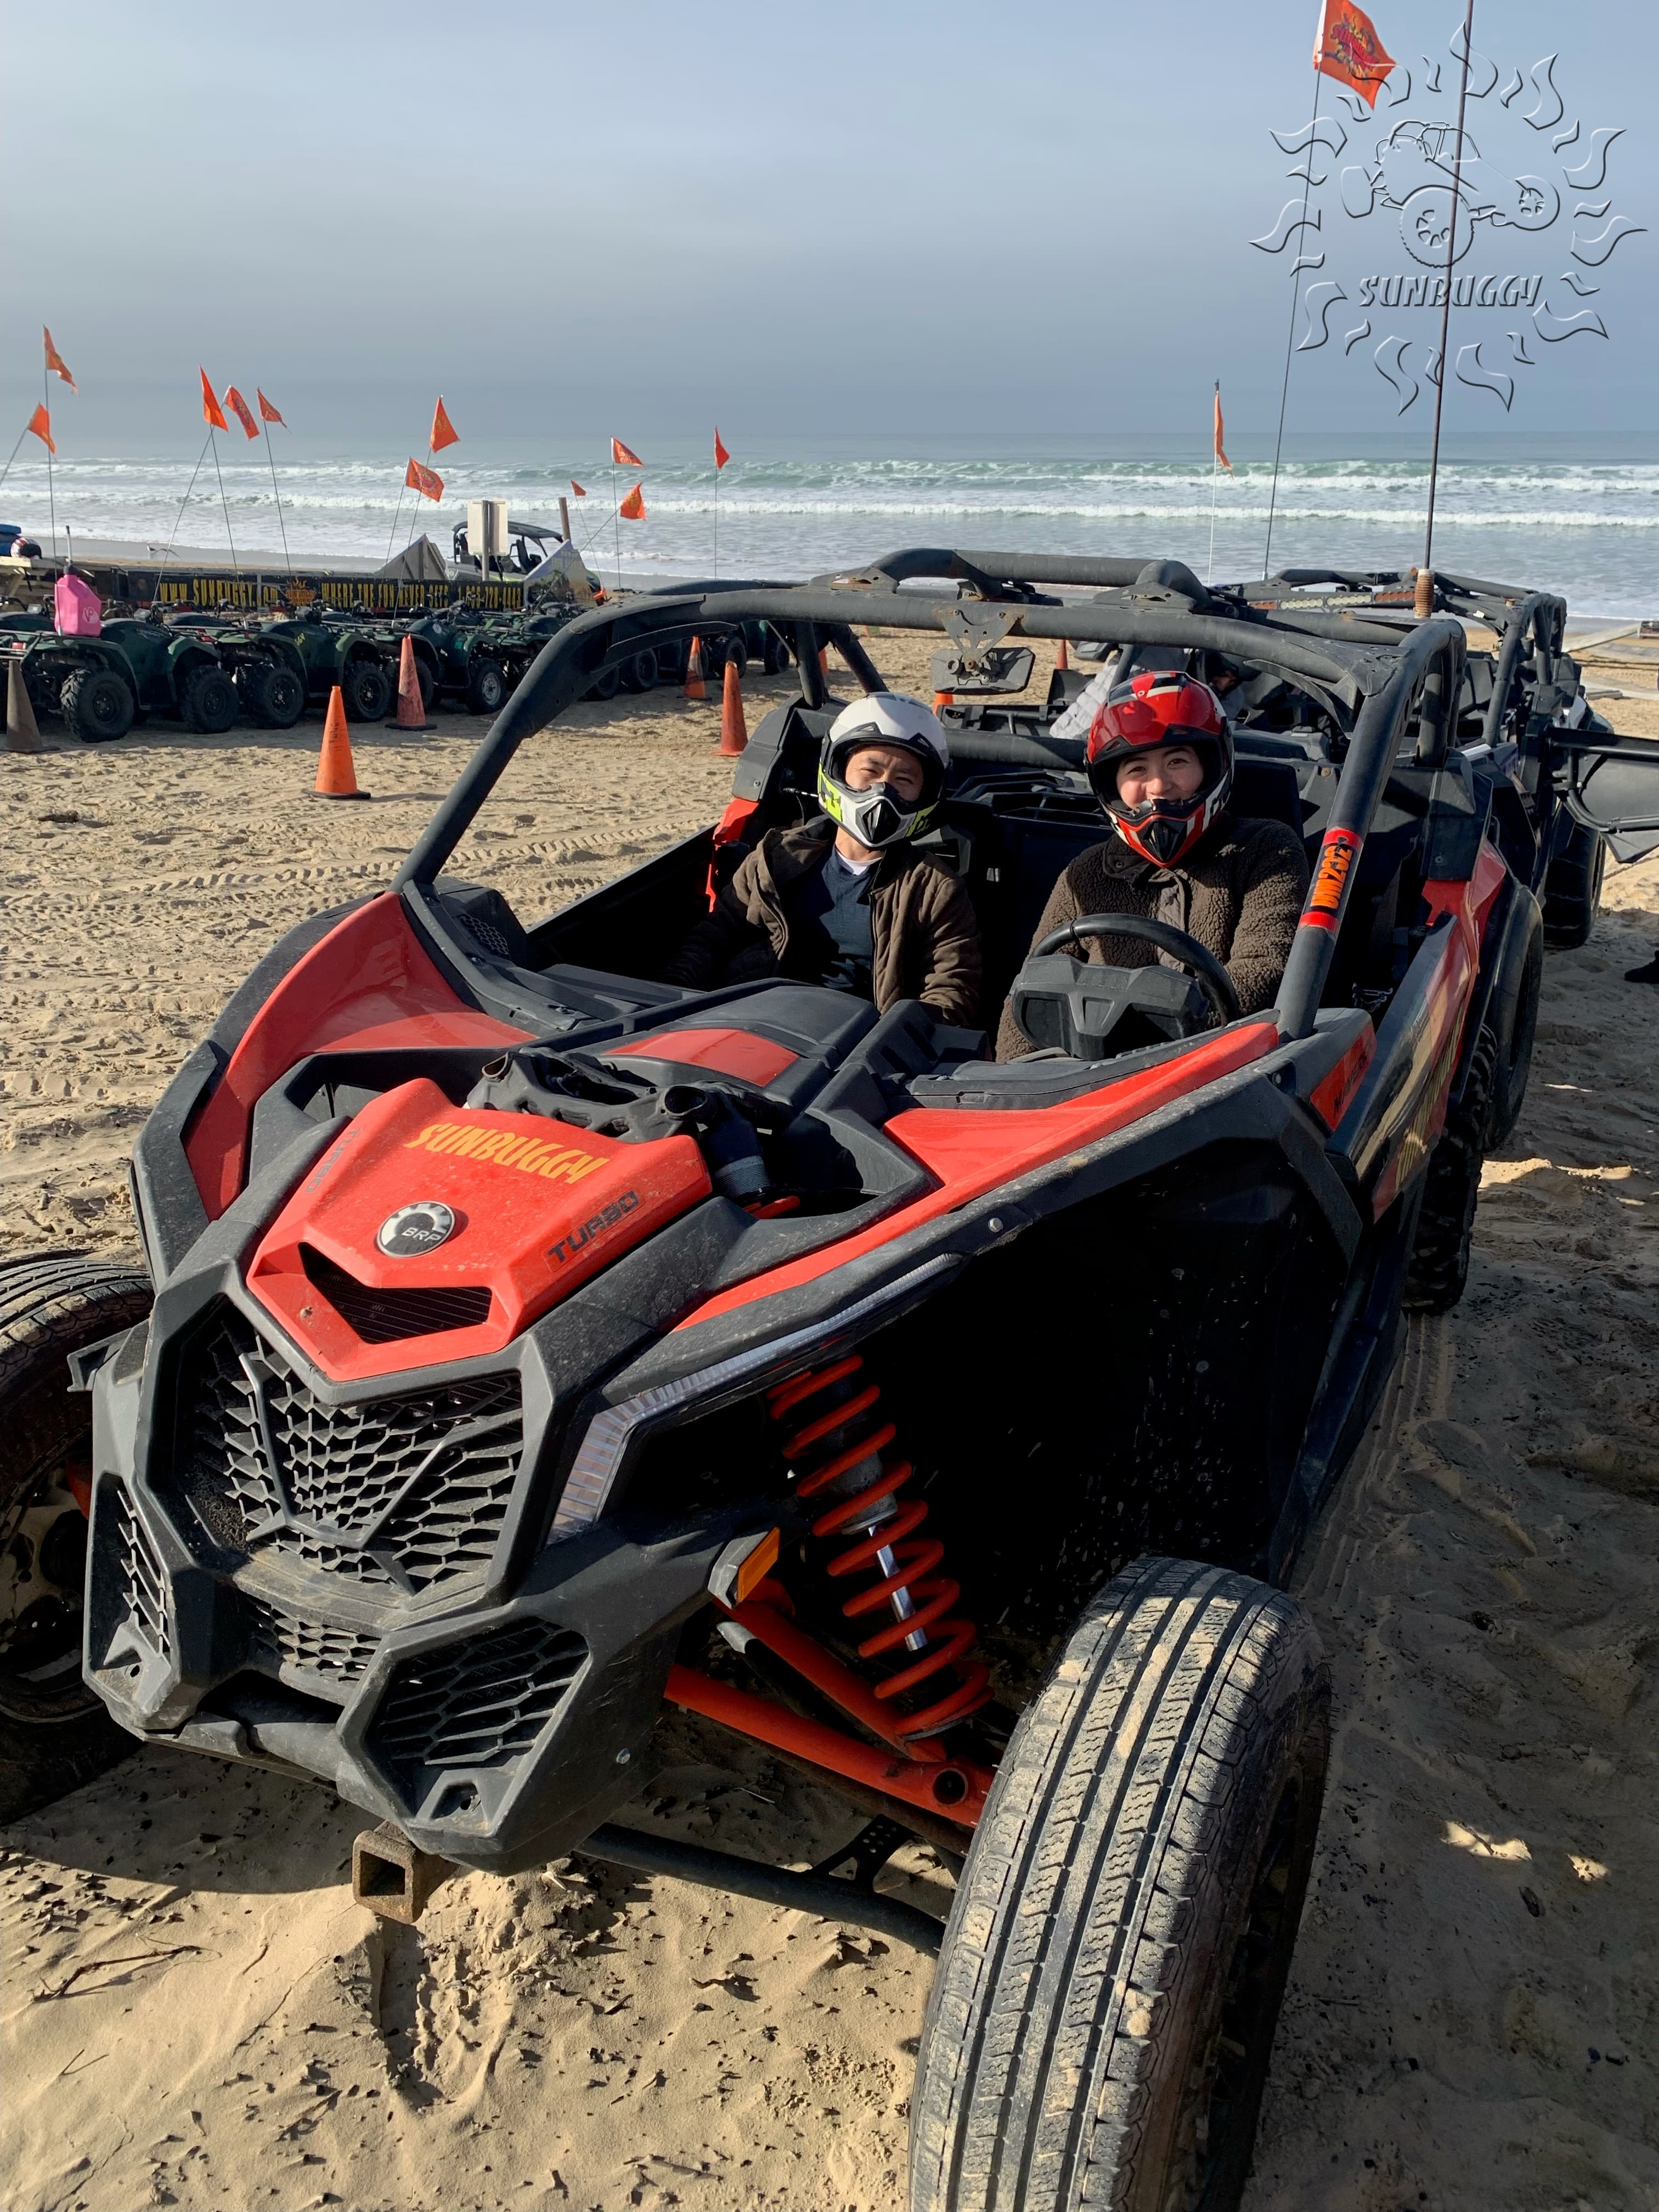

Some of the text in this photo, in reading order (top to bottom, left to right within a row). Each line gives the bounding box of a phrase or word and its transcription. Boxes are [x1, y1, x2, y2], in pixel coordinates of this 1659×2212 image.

[321, 583, 448, 608] WHERE THE FUN NEVER SETS
[403, 1123, 610, 1184] SUNBUGGY
[402, 1227, 442, 1242] BRP
[548, 1190, 638, 1263] TURBO
